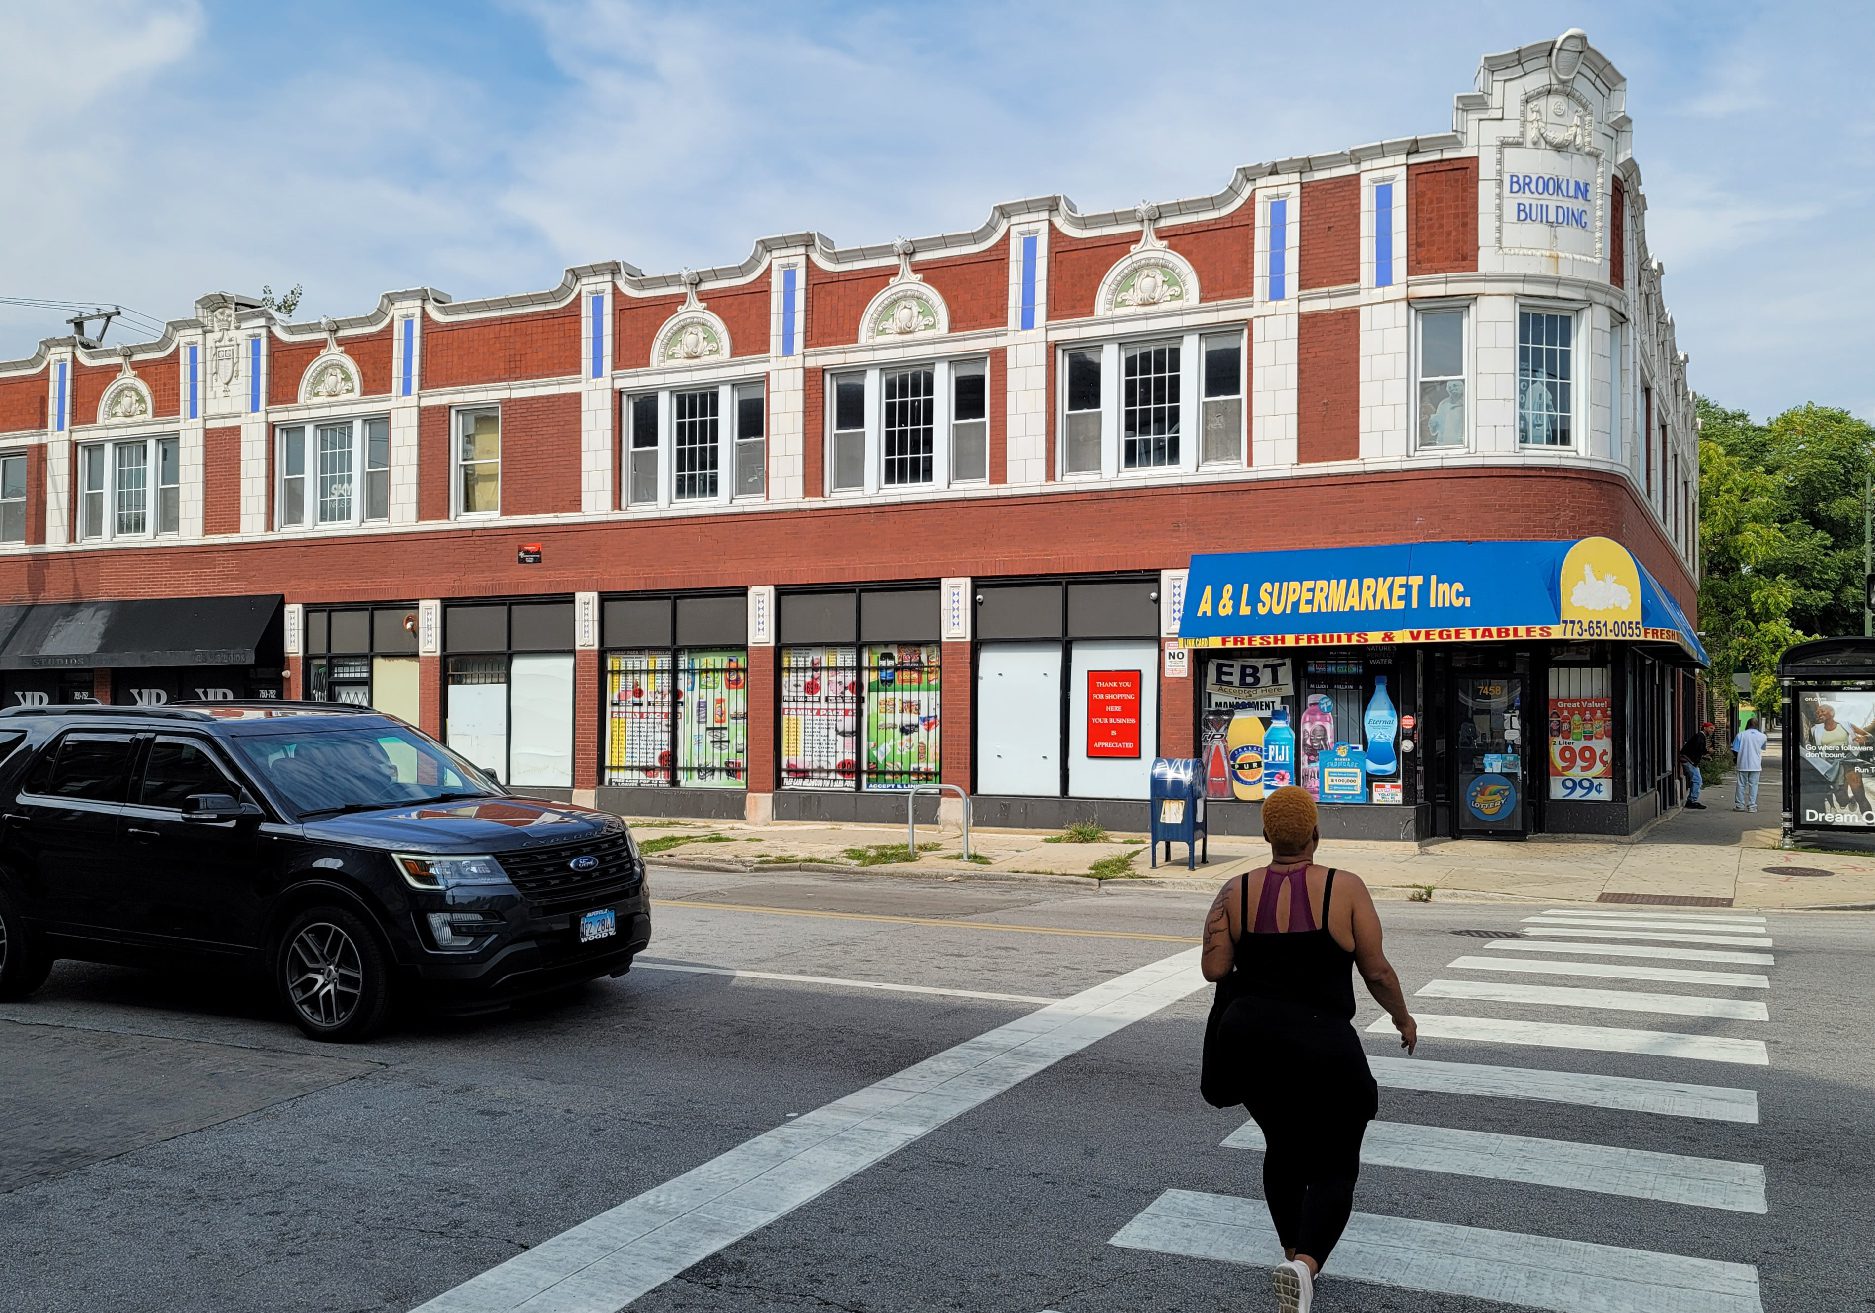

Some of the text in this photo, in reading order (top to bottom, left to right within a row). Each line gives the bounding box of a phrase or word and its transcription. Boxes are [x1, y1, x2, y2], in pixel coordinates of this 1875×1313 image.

[1509, 174, 1591, 202] BROOKLINE
[1516, 202, 1588, 229] BUILDING
[1197, 574, 1471, 616] A & L SUPERMARKET Inc.
[1221, 626, 1552, 647] FRESH FRUITS & VEGETABLES
[1561, 619, 1642, 638] 773-651-0055
[1643, 628, 1676, 641] FRESH
[1168, 651, 1185, 661] NO
[1215, 661, 1287, 687] EBT
[1217, 685, 1283, 695] Accepted Here
[1477, 686, 1501, 696] 7458
[784, 708, 818, 716] FAMILY
[820, 708, 845, 716] PACK
[1367, 718, 1395, 726] Eternal
[1268, 744, 1290, 762] FIJI
[1805, 743, 1817, 751] Go
[1558, 745, 1609, 773] 99¢
[1561, 777, 1604, 799] 99¢
[1471, 797, 1507, 809] LOTTERY
[1805, 809, 1859, 823] Dream
